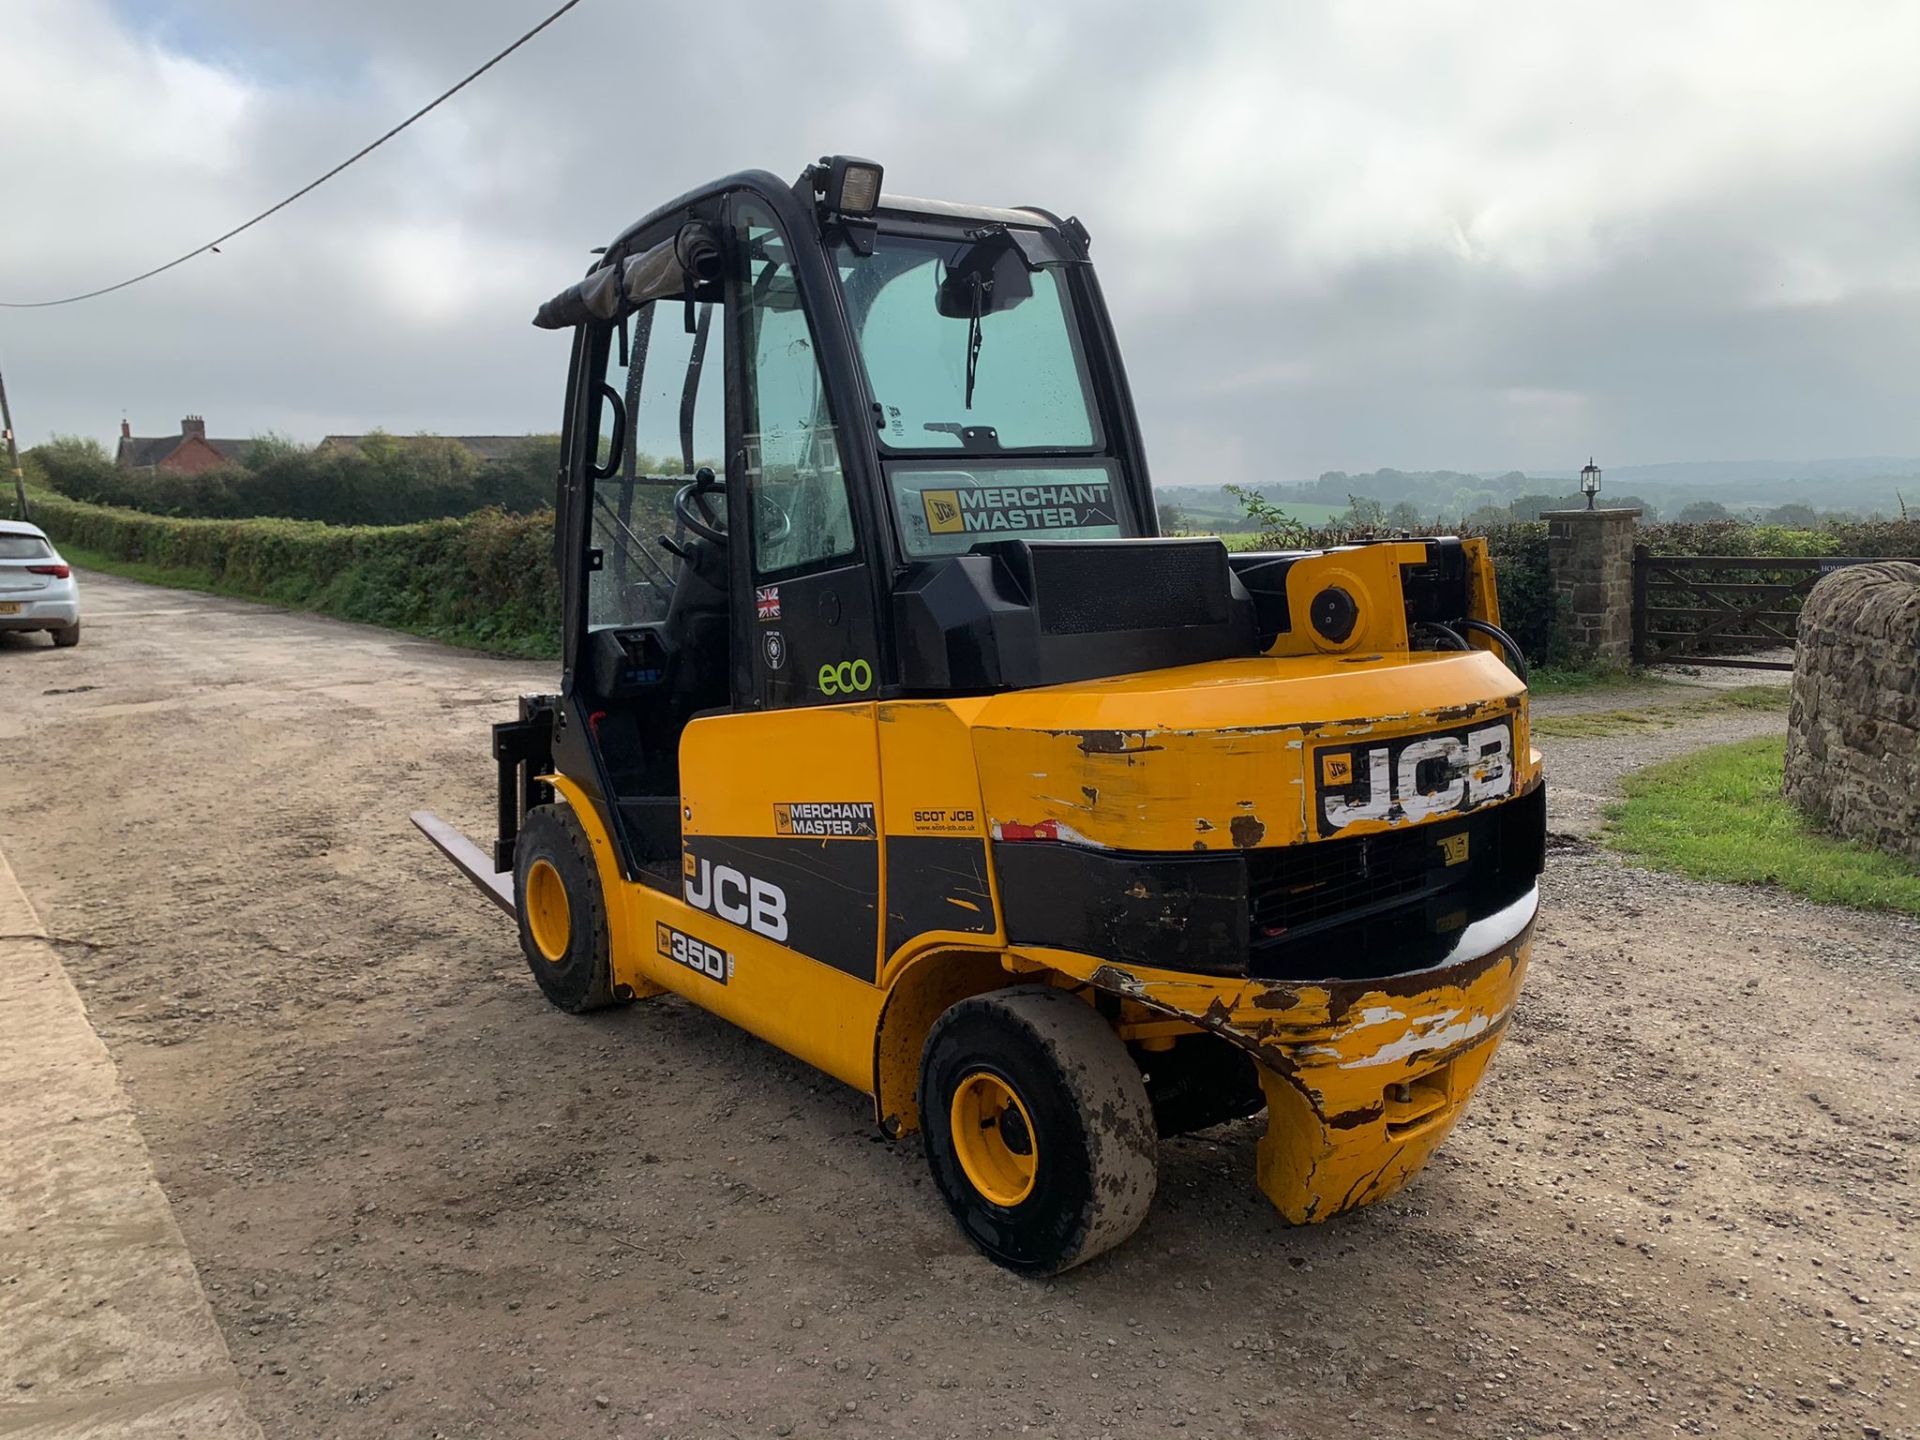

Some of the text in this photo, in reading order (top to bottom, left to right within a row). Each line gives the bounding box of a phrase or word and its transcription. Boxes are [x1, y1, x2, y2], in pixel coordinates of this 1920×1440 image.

[957, 485, 1109, 509] MERCHANT
[933, 501, 956, 521] JCB
[962, 508, 1078, 531] MASTER
[818, 659, 872, 696] eco
[1324, 723, 1512, 828] JCB
[1330, 763, 1348, 777] JCB
[790, 804, 873, 819] MERCHANT
[914, 811, 975, 822] SCOT JCB
[792, 819, 853, 835] MASTER
[685, 858, 788, 942] JCB
[671, 931, 724, 980] 35D
